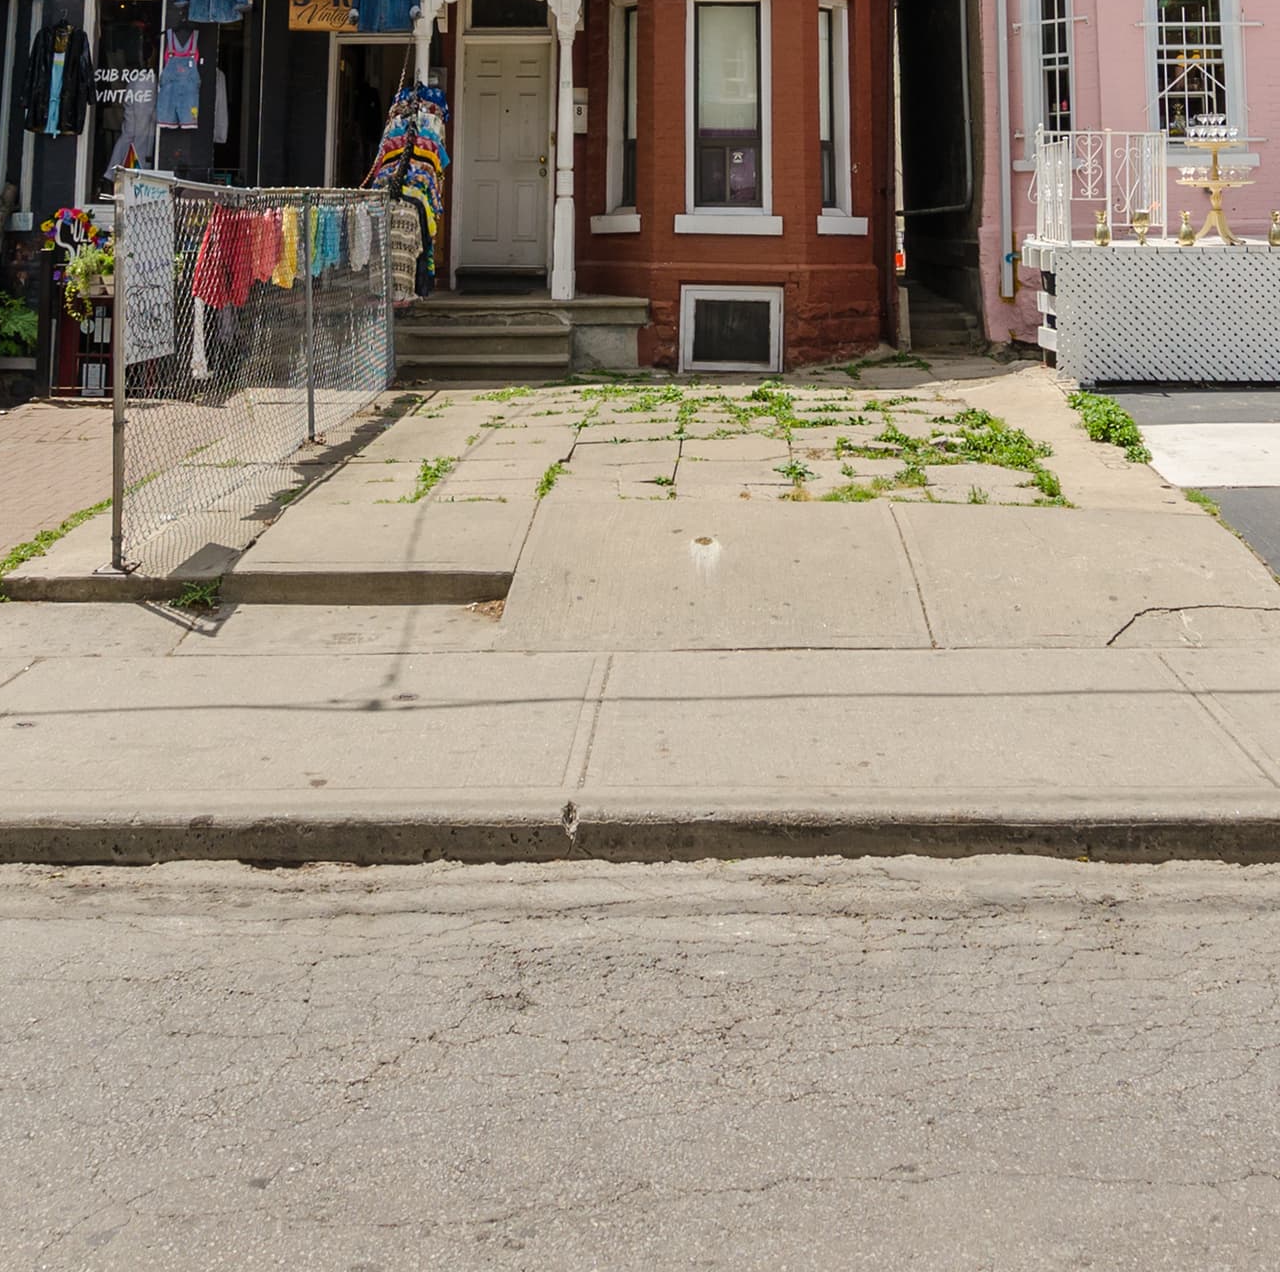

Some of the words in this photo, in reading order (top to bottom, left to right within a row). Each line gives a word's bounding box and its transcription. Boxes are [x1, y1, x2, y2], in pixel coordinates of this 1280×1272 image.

[297, 1, 351, 28] Vintag
[94, 68, 119, 82] SUB
[121, 68, 156, 83] ROSA
[95, 88, 153, 104] VINTAGE
